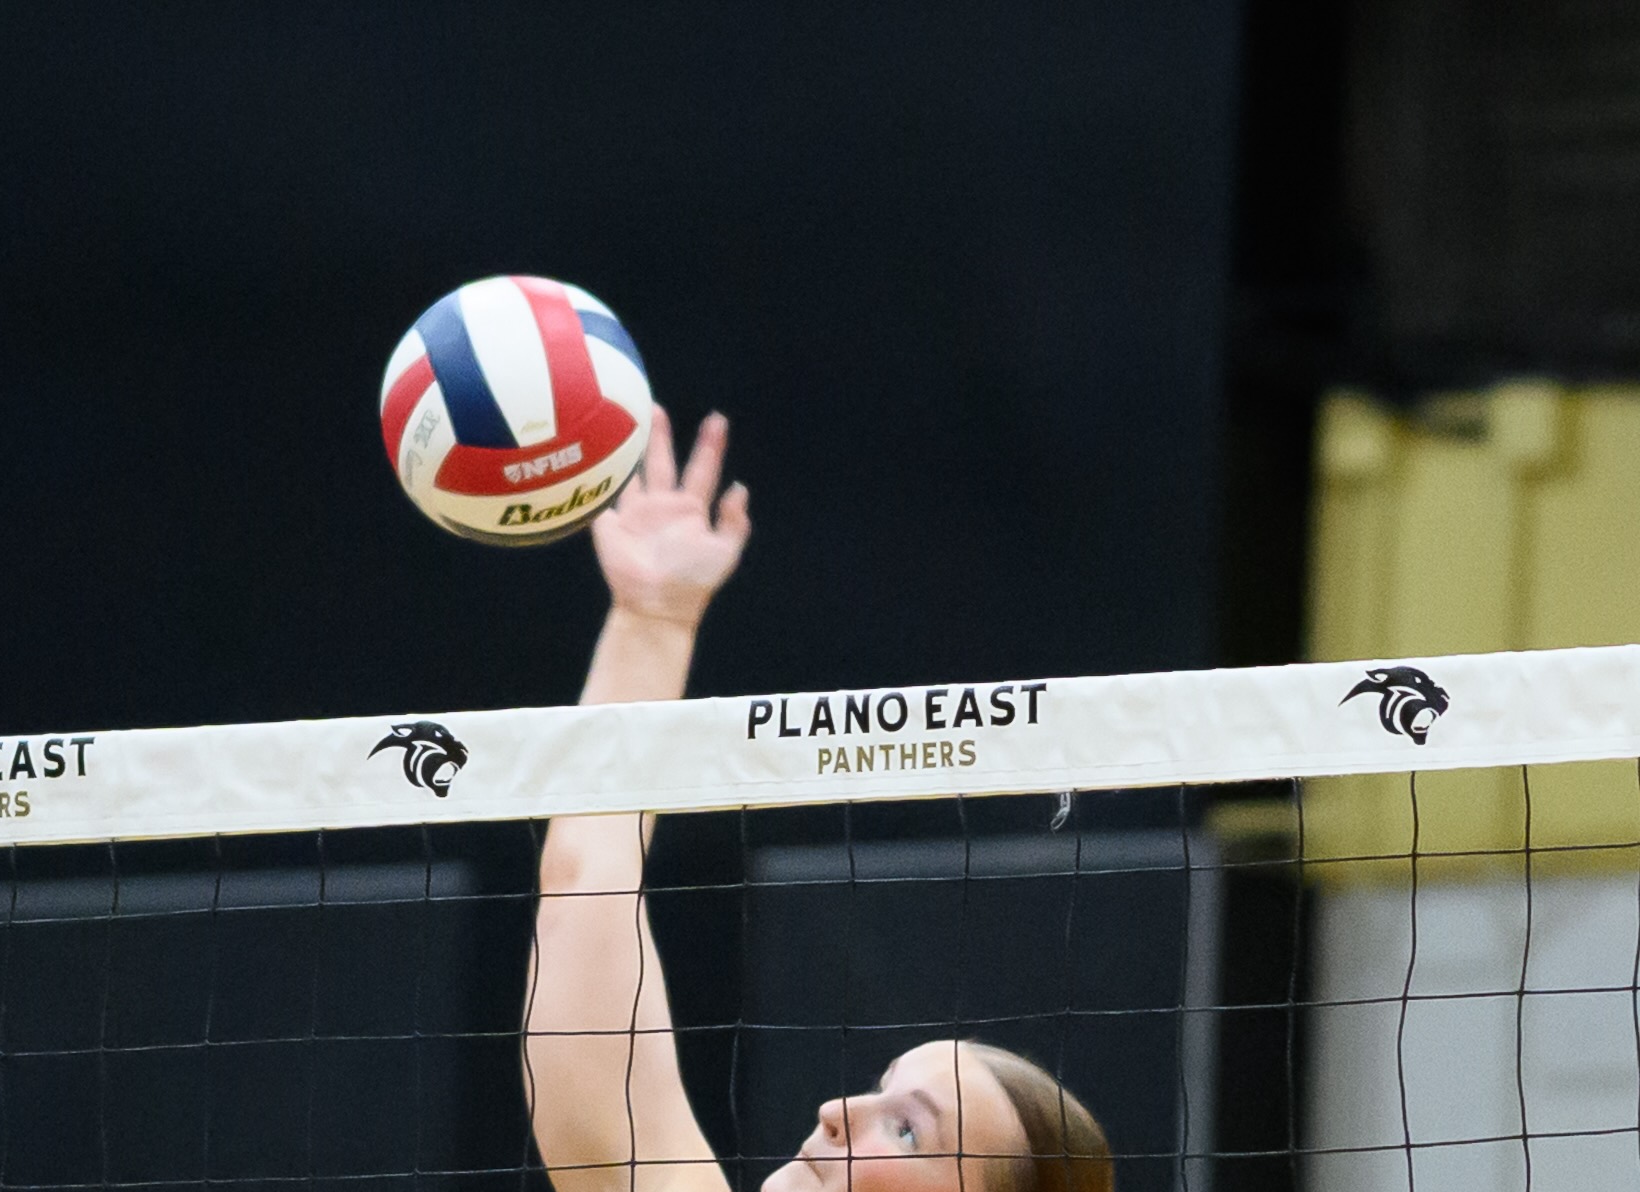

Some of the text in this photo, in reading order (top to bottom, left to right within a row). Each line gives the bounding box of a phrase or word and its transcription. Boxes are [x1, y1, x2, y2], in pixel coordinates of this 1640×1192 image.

[498, 476, 613, 526] Baden
[747, 682, 1048, 740] PLANO EAST
[817, 739, 977, 775] PANTHERS
